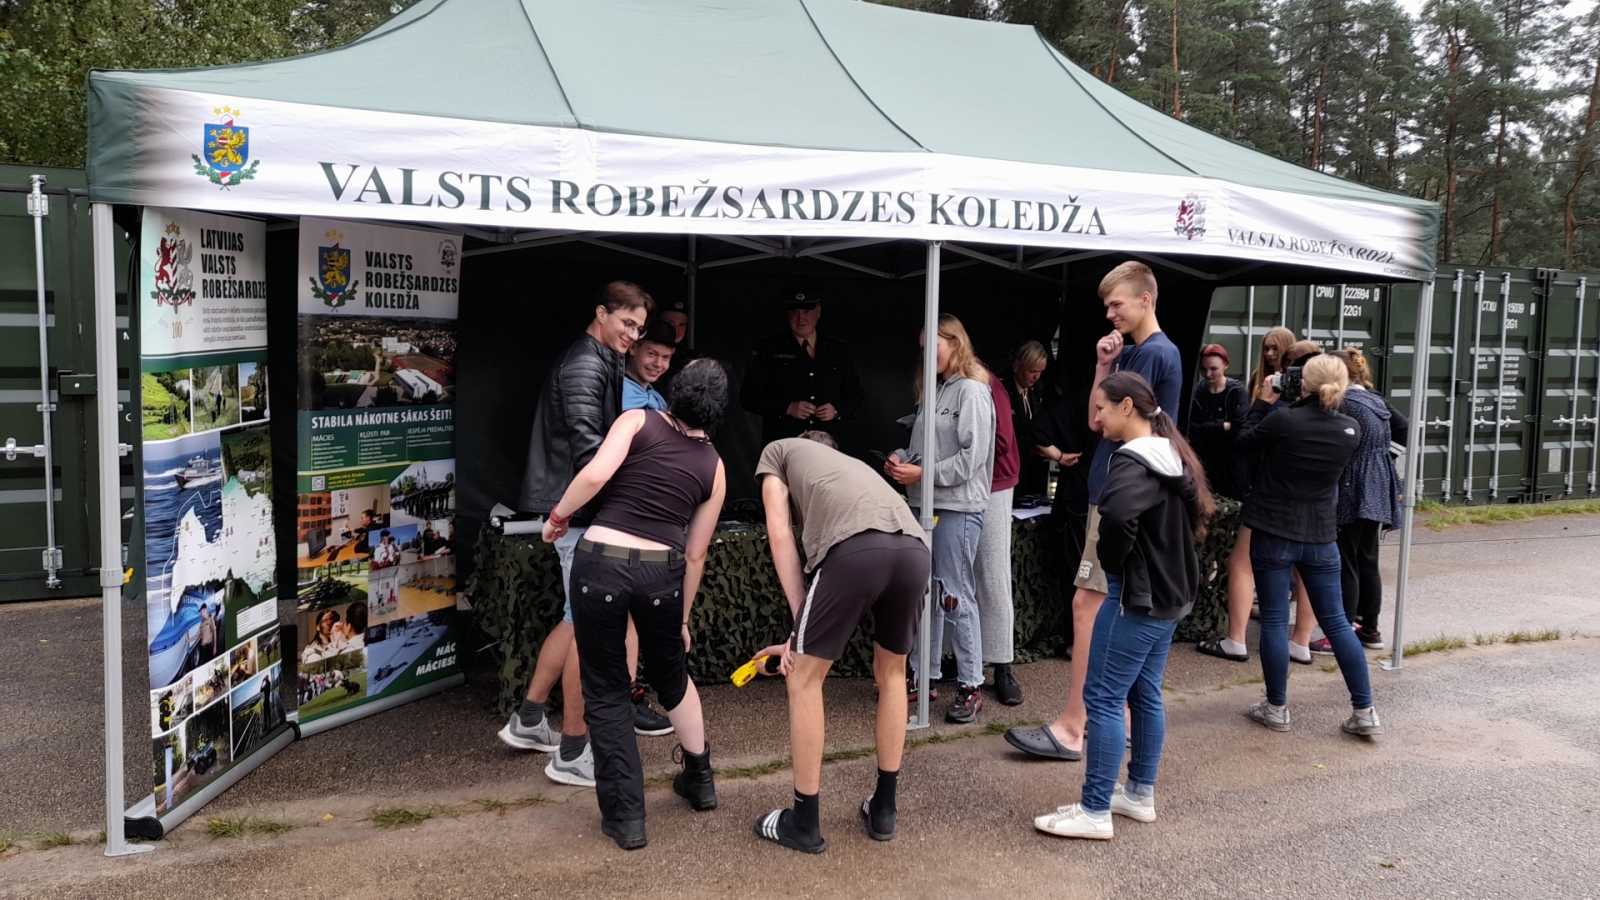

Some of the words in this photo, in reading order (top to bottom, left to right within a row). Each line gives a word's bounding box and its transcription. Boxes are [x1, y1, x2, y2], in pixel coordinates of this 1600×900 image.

[317, 161, 532, 213] VALSTS
[547, 178, 916, 224] ROBEŽSARDZES
[928, 193, 1108, 237] KOLEDŽA
[200, 228, 244, 253] LATVIJAS
[1228, 228, 1286, 250] VALSTS
[1289, 236, 1398, 265] ROBEŽSARDZE
[200, 253, 237, 276] VALSTS
[365, 250, 413, 271] VALSTS
[202, 276, 266, 299] ROBEŽSARDZE
[365, 271, 458, 293] ROBEŽSARDZES
[365, 291, 420, 310] KOLEDŽA
[1315, 285, 1335, 298] CPWU
[1344, 287, 1370, 300] 222694
[1343, 304, 1362, 317] 22G1
[1482, 300, 1497, 312] CTXU
[1507, 302, 1525, 314] 15039
[171, 321, 183, 339] 100
[1505, 318, 1518, 329] 2G1
[311, 413, 353, 429] STABILA
[355, 411, 399, 426] NĀKOTNE
[400, 409, 429, 423] SĀKAS
[430, 409, 453, 421] ŠEIT!
[312, 434, 335, 442] MĀCIES
[380, 429, 391, 437] PAR
[436, 642, 457, 657] NĀC
[415, 654, 456, 676] MĀCIES!
